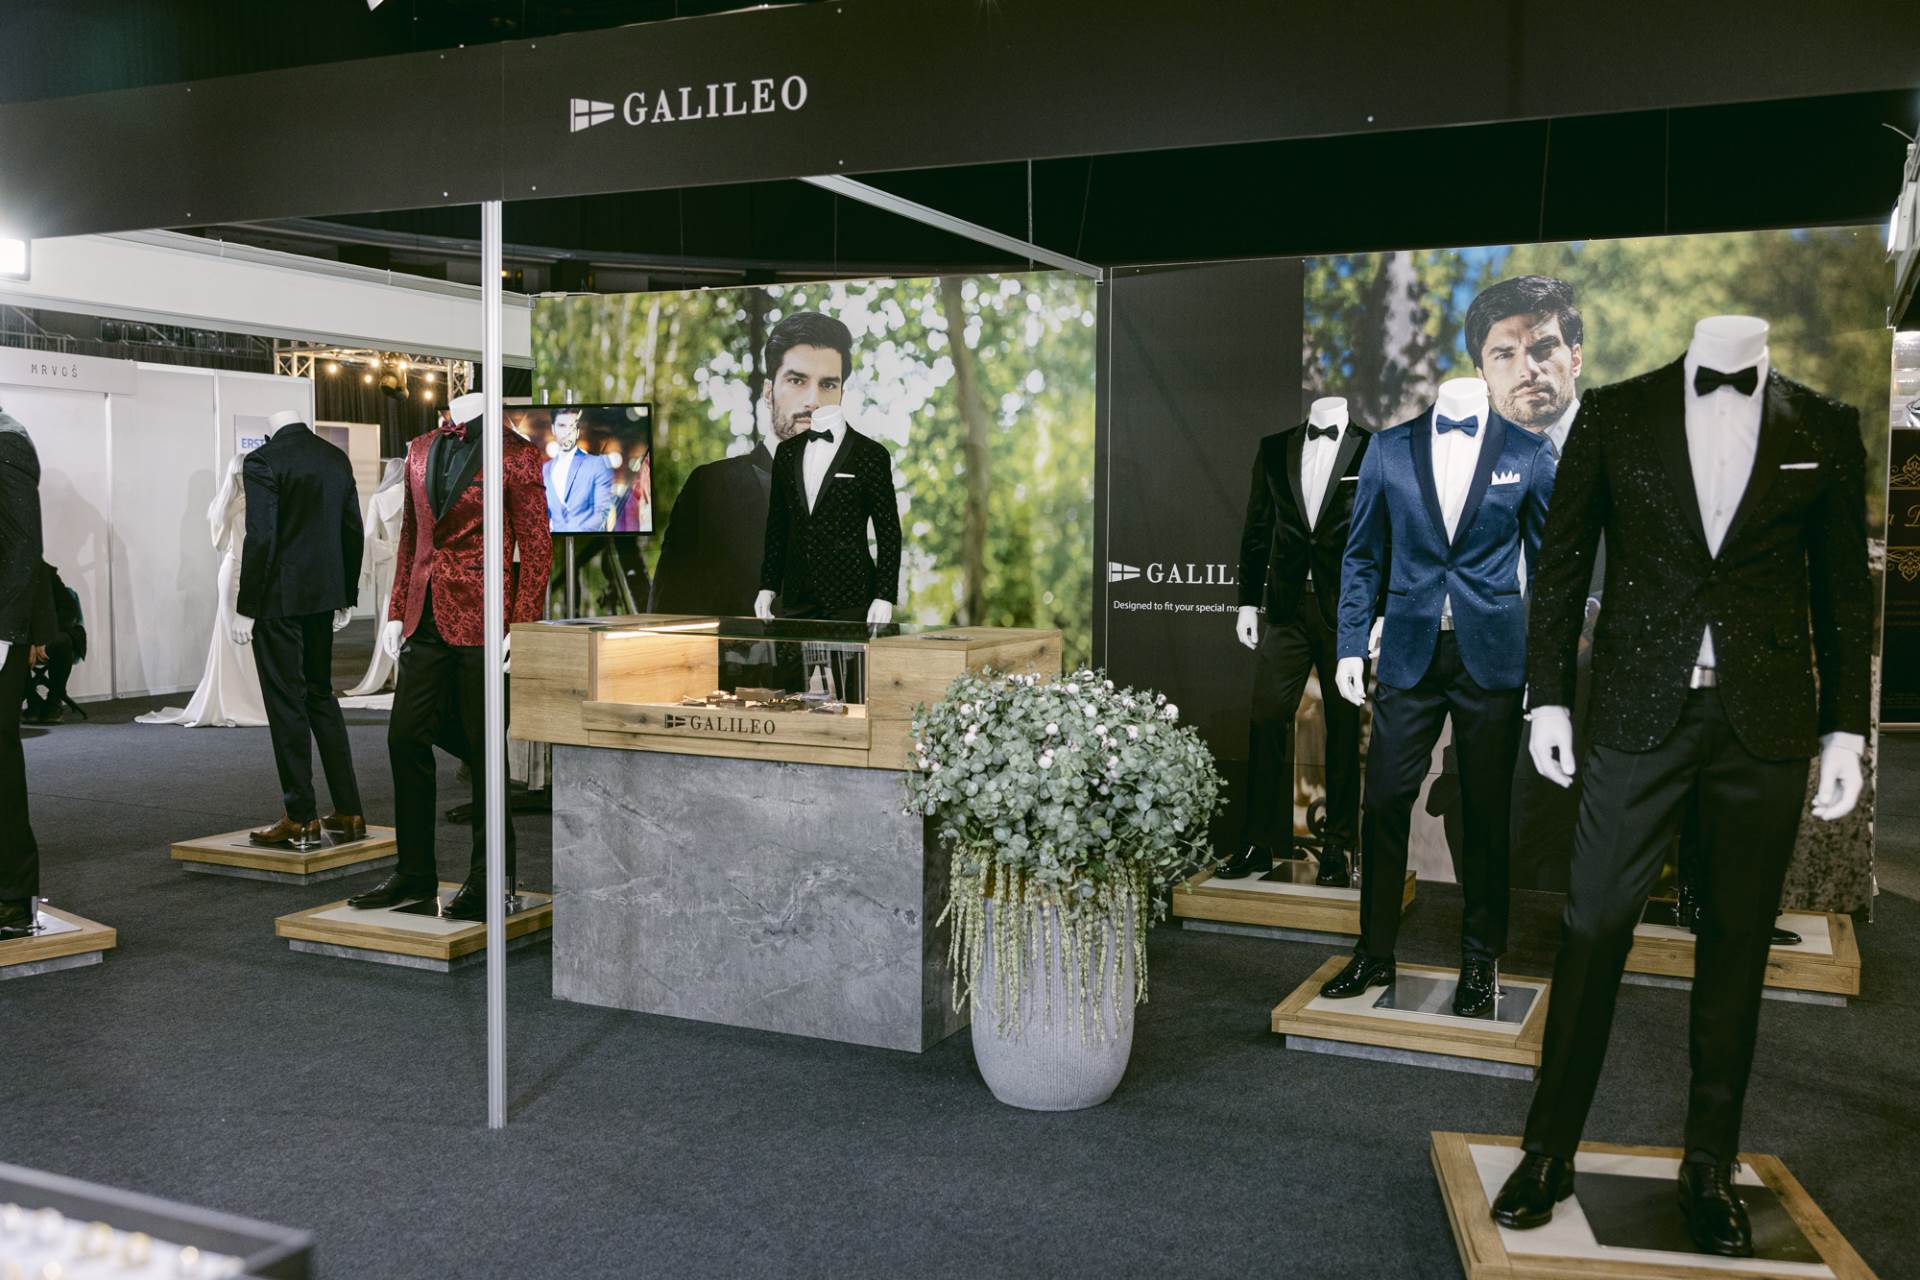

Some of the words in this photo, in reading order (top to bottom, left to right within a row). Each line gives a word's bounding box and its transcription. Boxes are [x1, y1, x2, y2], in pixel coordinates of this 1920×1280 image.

[623, 75, 808, 126] GALILEO
[1146, 562, 1269, 586] GALIL
[1113, 600, 1152, 612] Designed
[1153, 602, 1163, 611] to
[1164, 601, 1173, 611] fit
[1174, 603, 1194, 614] your
[1195, 603, 1225, 614] special
[690, 714, 776, 736] GALILEO
